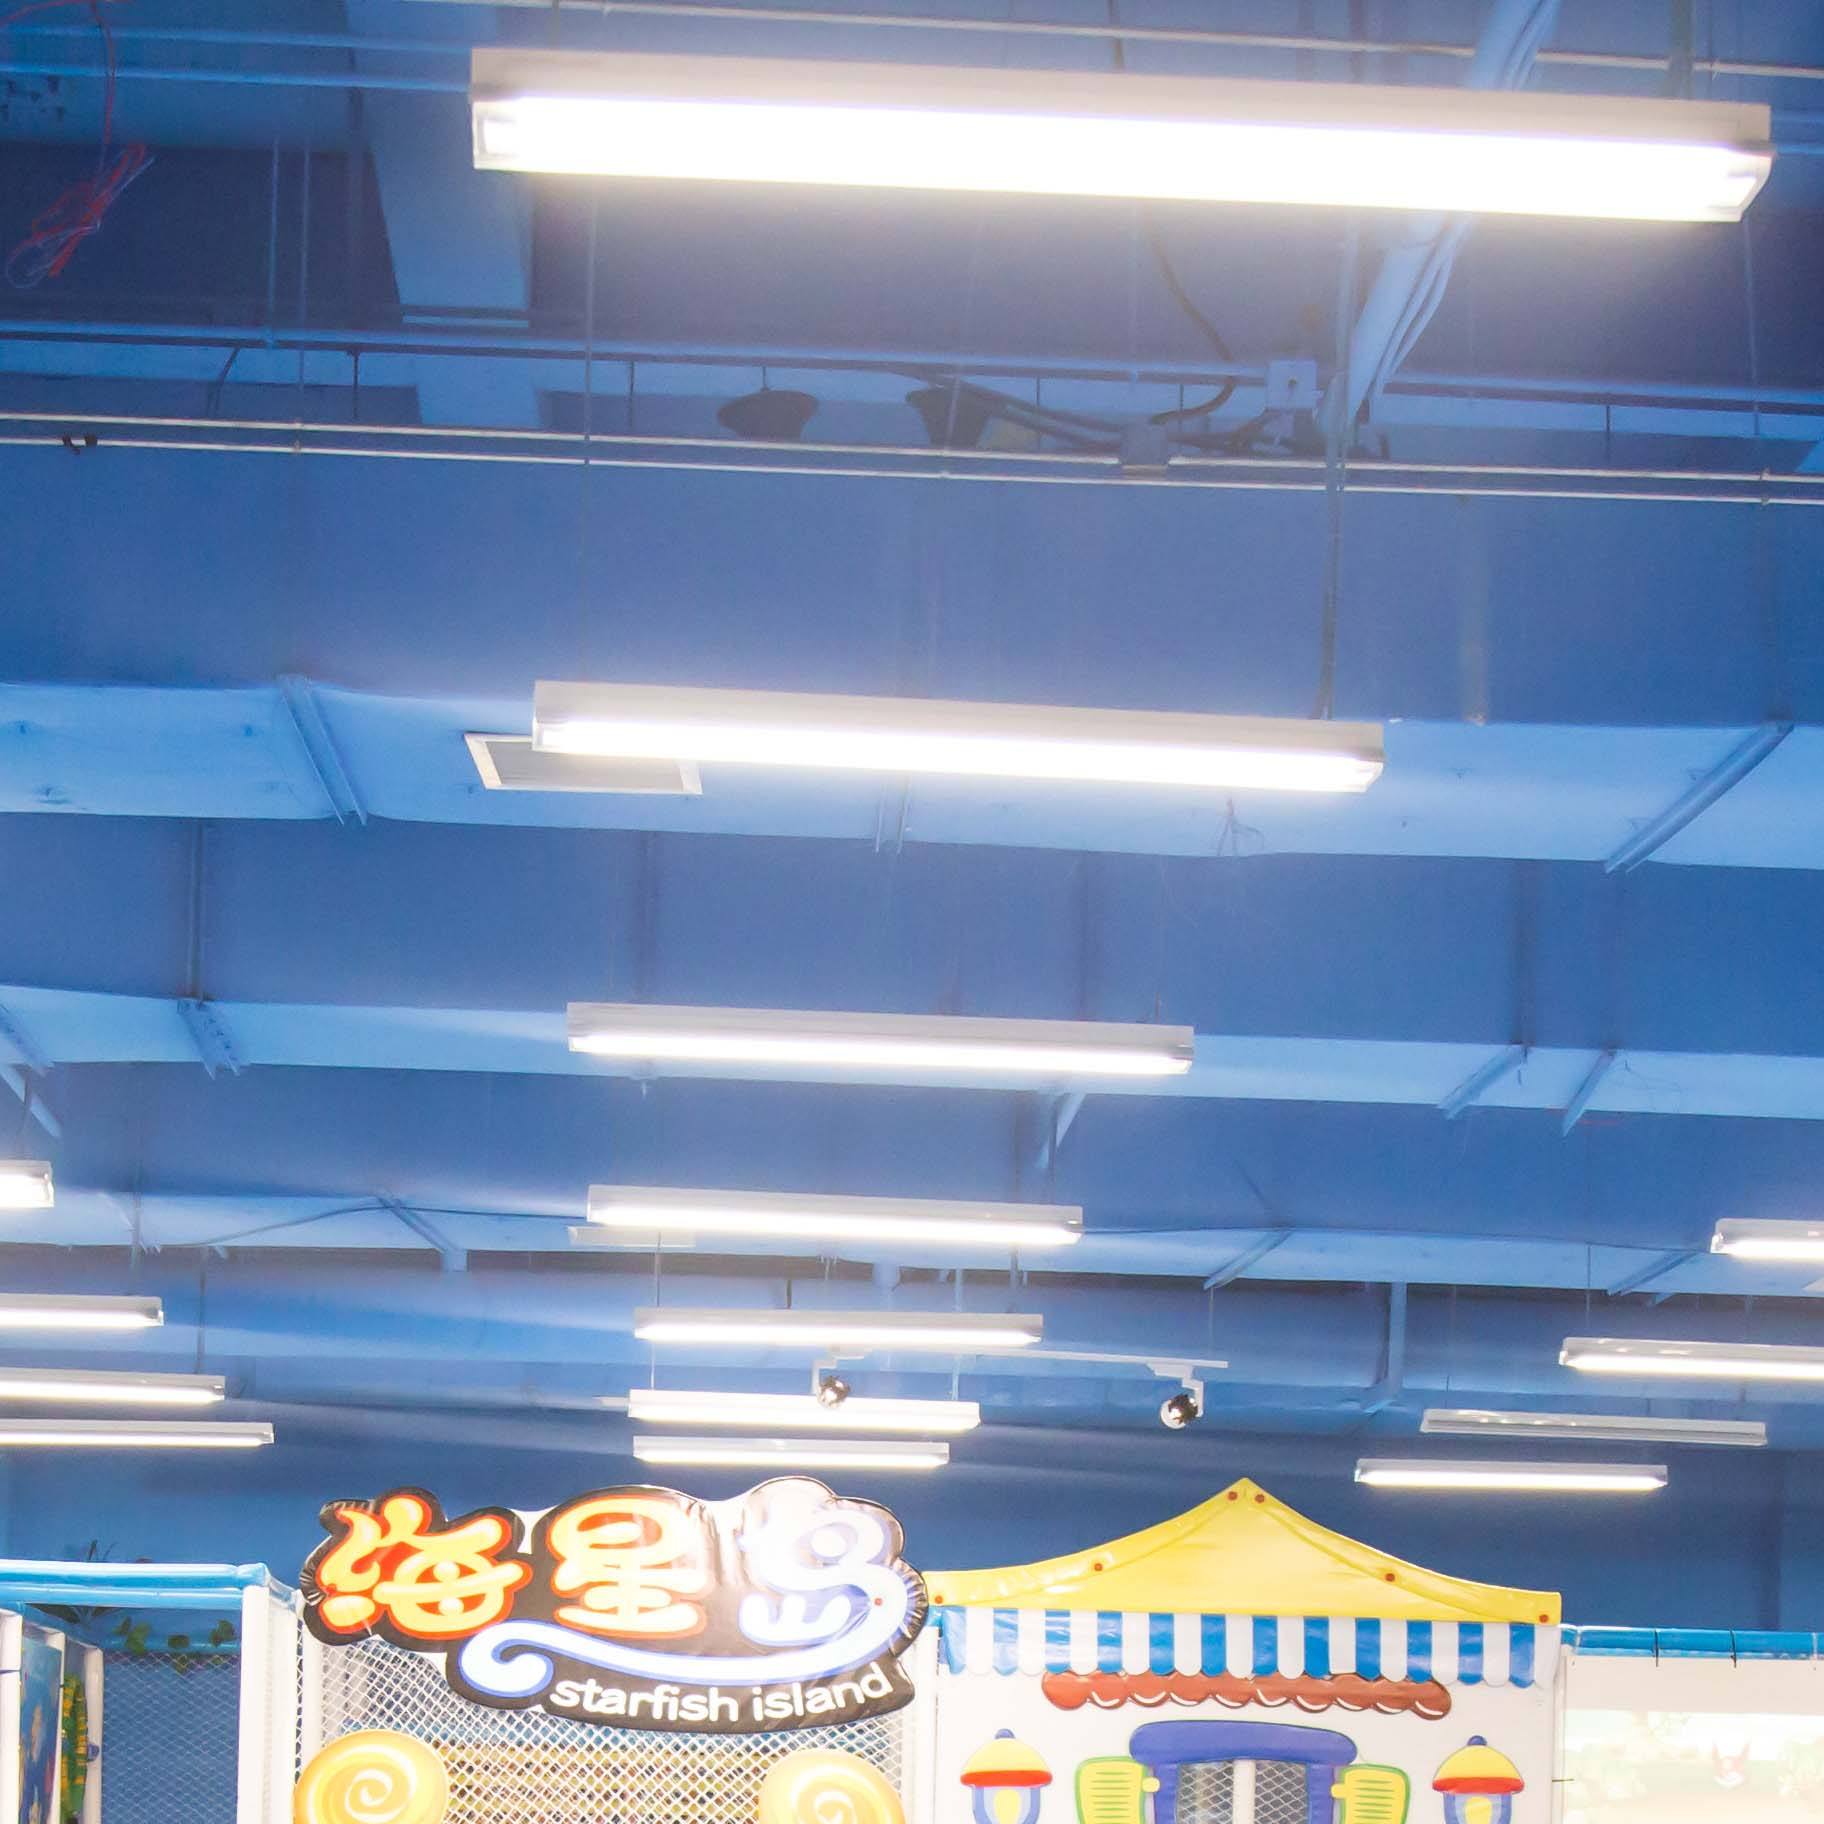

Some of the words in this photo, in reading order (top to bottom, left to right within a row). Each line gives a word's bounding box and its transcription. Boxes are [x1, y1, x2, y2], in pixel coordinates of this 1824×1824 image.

[317, 1485, 912, 1697] 海星岛
[550, 1678, 739, 1722] starfish
[752, 1661, 894, 1721] island
